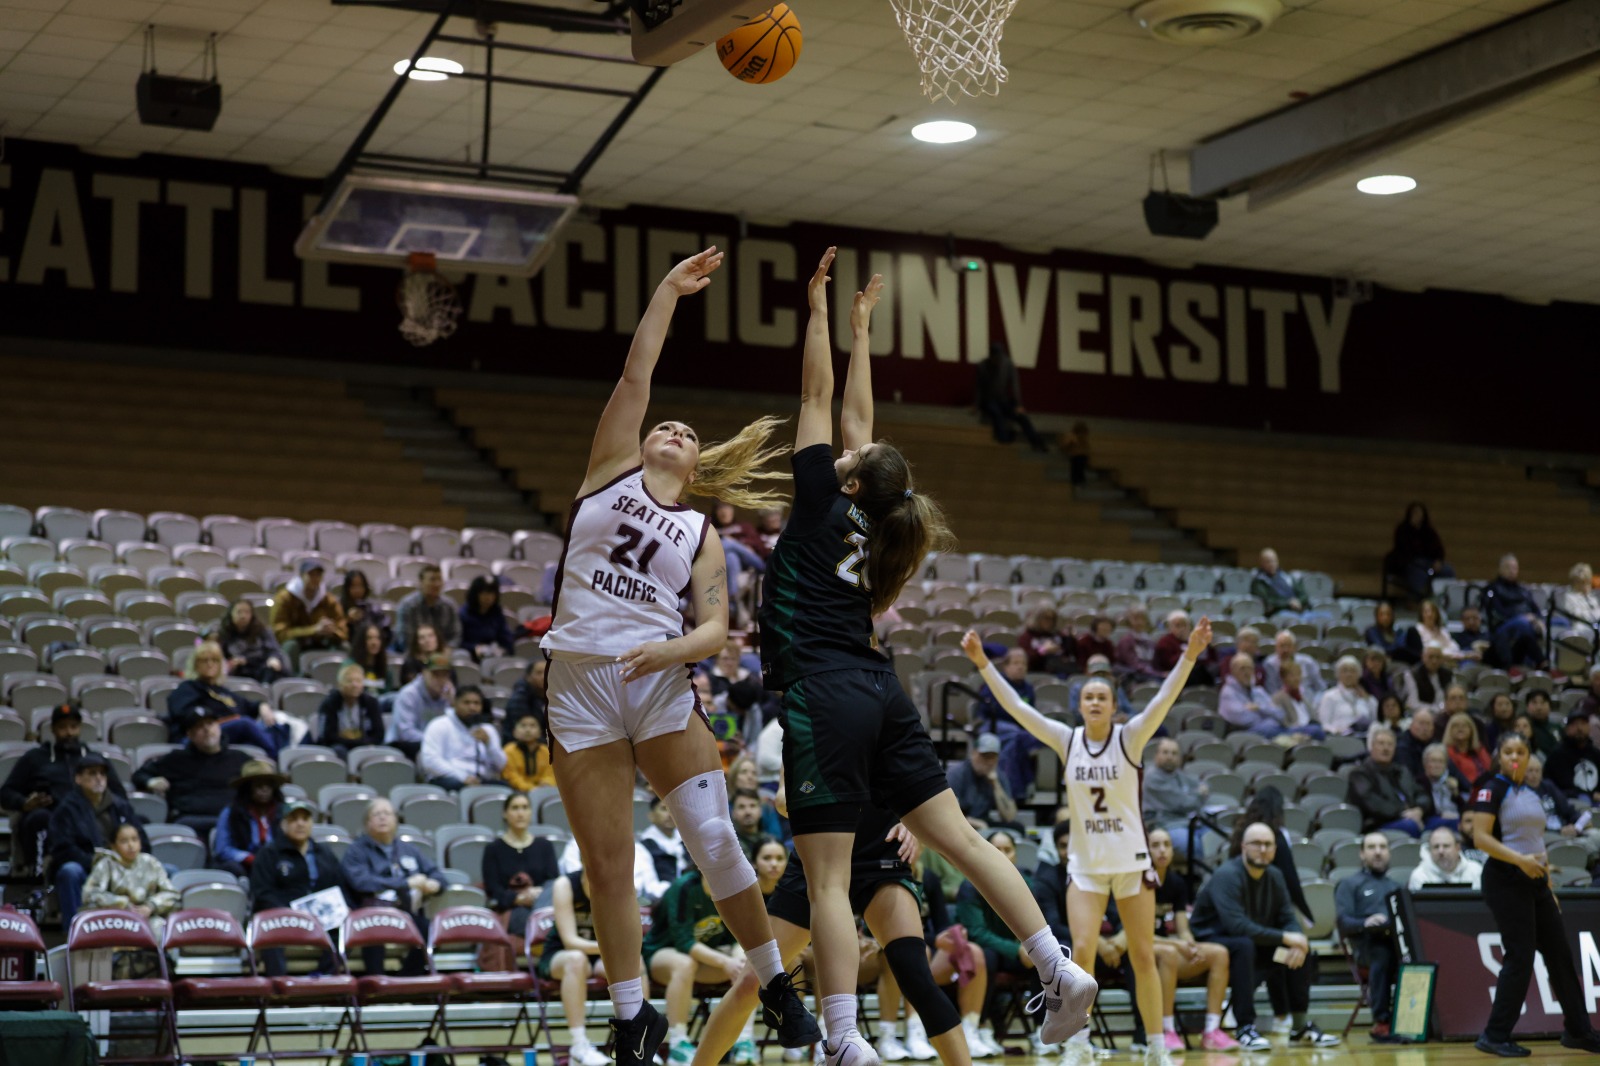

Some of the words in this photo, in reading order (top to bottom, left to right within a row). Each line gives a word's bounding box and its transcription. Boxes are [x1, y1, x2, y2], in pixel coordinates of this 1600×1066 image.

[0, 163, 363, 313] ATTLE
[834, 246, 1354, 393] UNIVERSITY
[612, 495, 685, 547] SEATTLE
[610, 523, 662, 575] 21
[591, 569, 657, 603] PACIFIC
[1075, 766, 1118, 781] SEATTLE
[1090, 787, 1108, 813] 2
[1085, 818, 1124, 833] PACIFIC
[82, 917, 141, 934] FALCONS
[175, 917, 231, 933] FALCONS
[261, 916, 315, 932] FALCONS
[352, 915, 407, 932] FALCONS
[441, 915, 495, 930] FALCONS
